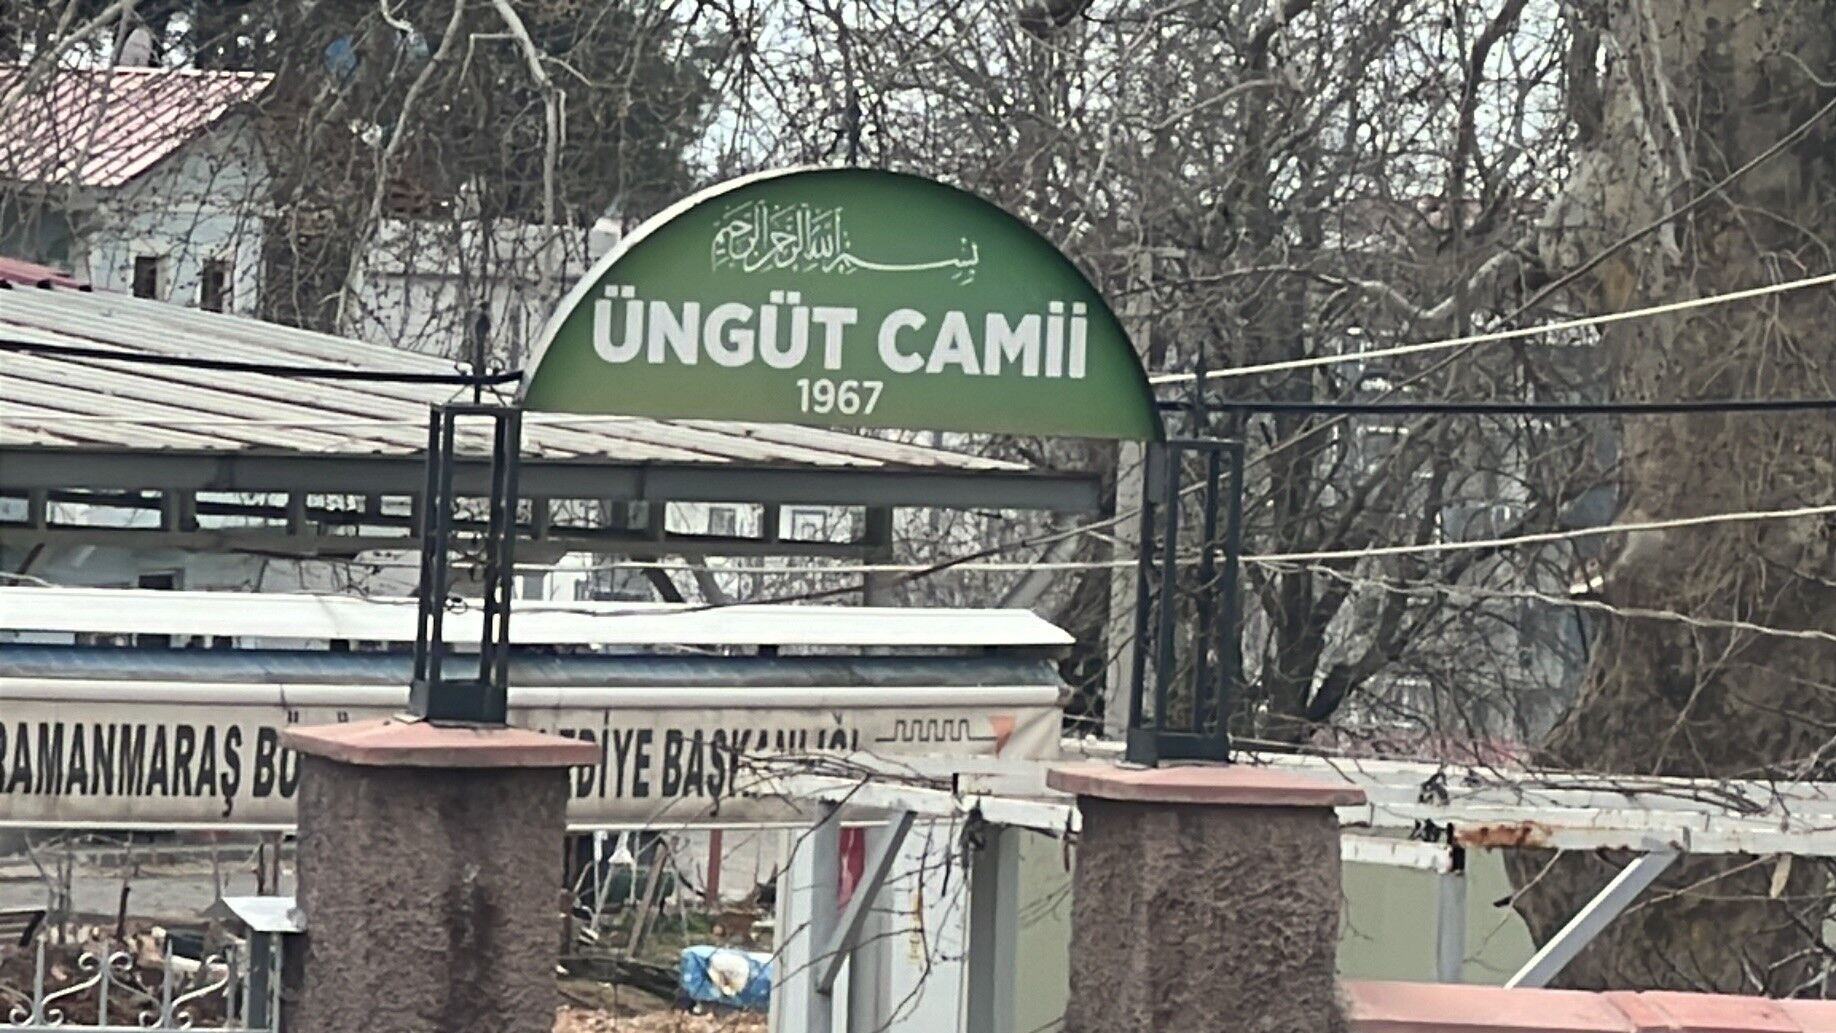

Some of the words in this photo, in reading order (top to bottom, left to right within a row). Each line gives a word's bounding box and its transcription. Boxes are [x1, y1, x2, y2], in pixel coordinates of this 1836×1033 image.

[593, 284, 857, 371] ÜNGÜT
[877, 301, 1088, 379] CAMİİ
[796, 379, 884, 415] 1967
